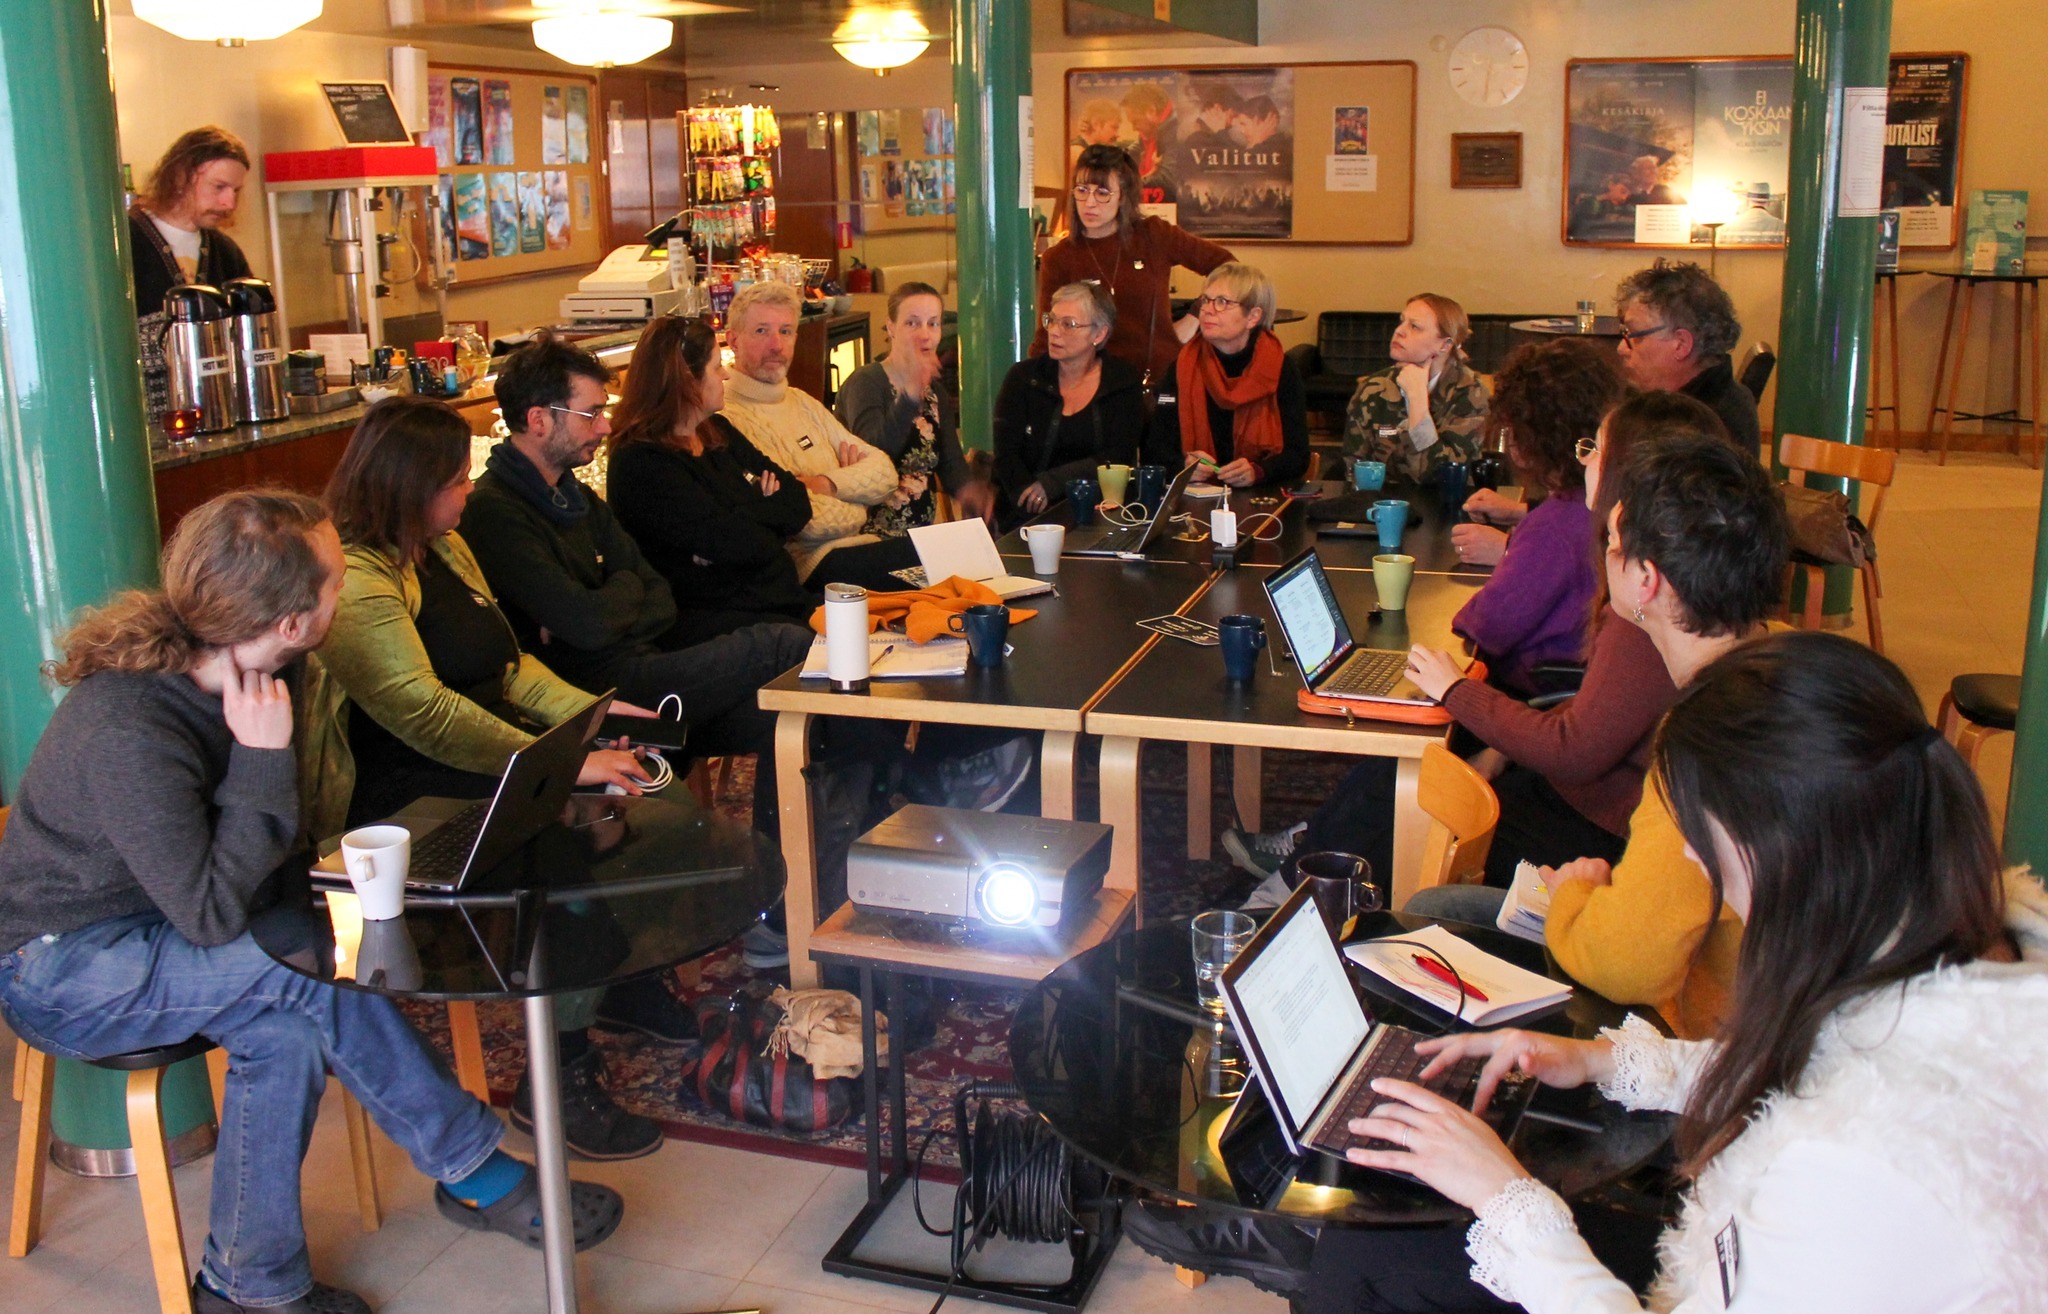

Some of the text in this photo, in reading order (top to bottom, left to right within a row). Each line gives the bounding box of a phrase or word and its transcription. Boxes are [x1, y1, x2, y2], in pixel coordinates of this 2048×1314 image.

[1756, 90, 1767, 105] EI
[1743, 121, 1780, 135] YKSIN
[1191, 148, 1280, 165] Valitut
[254, 351, 276, 362] COFFEE
[202, 361, 215, 371] HOT
